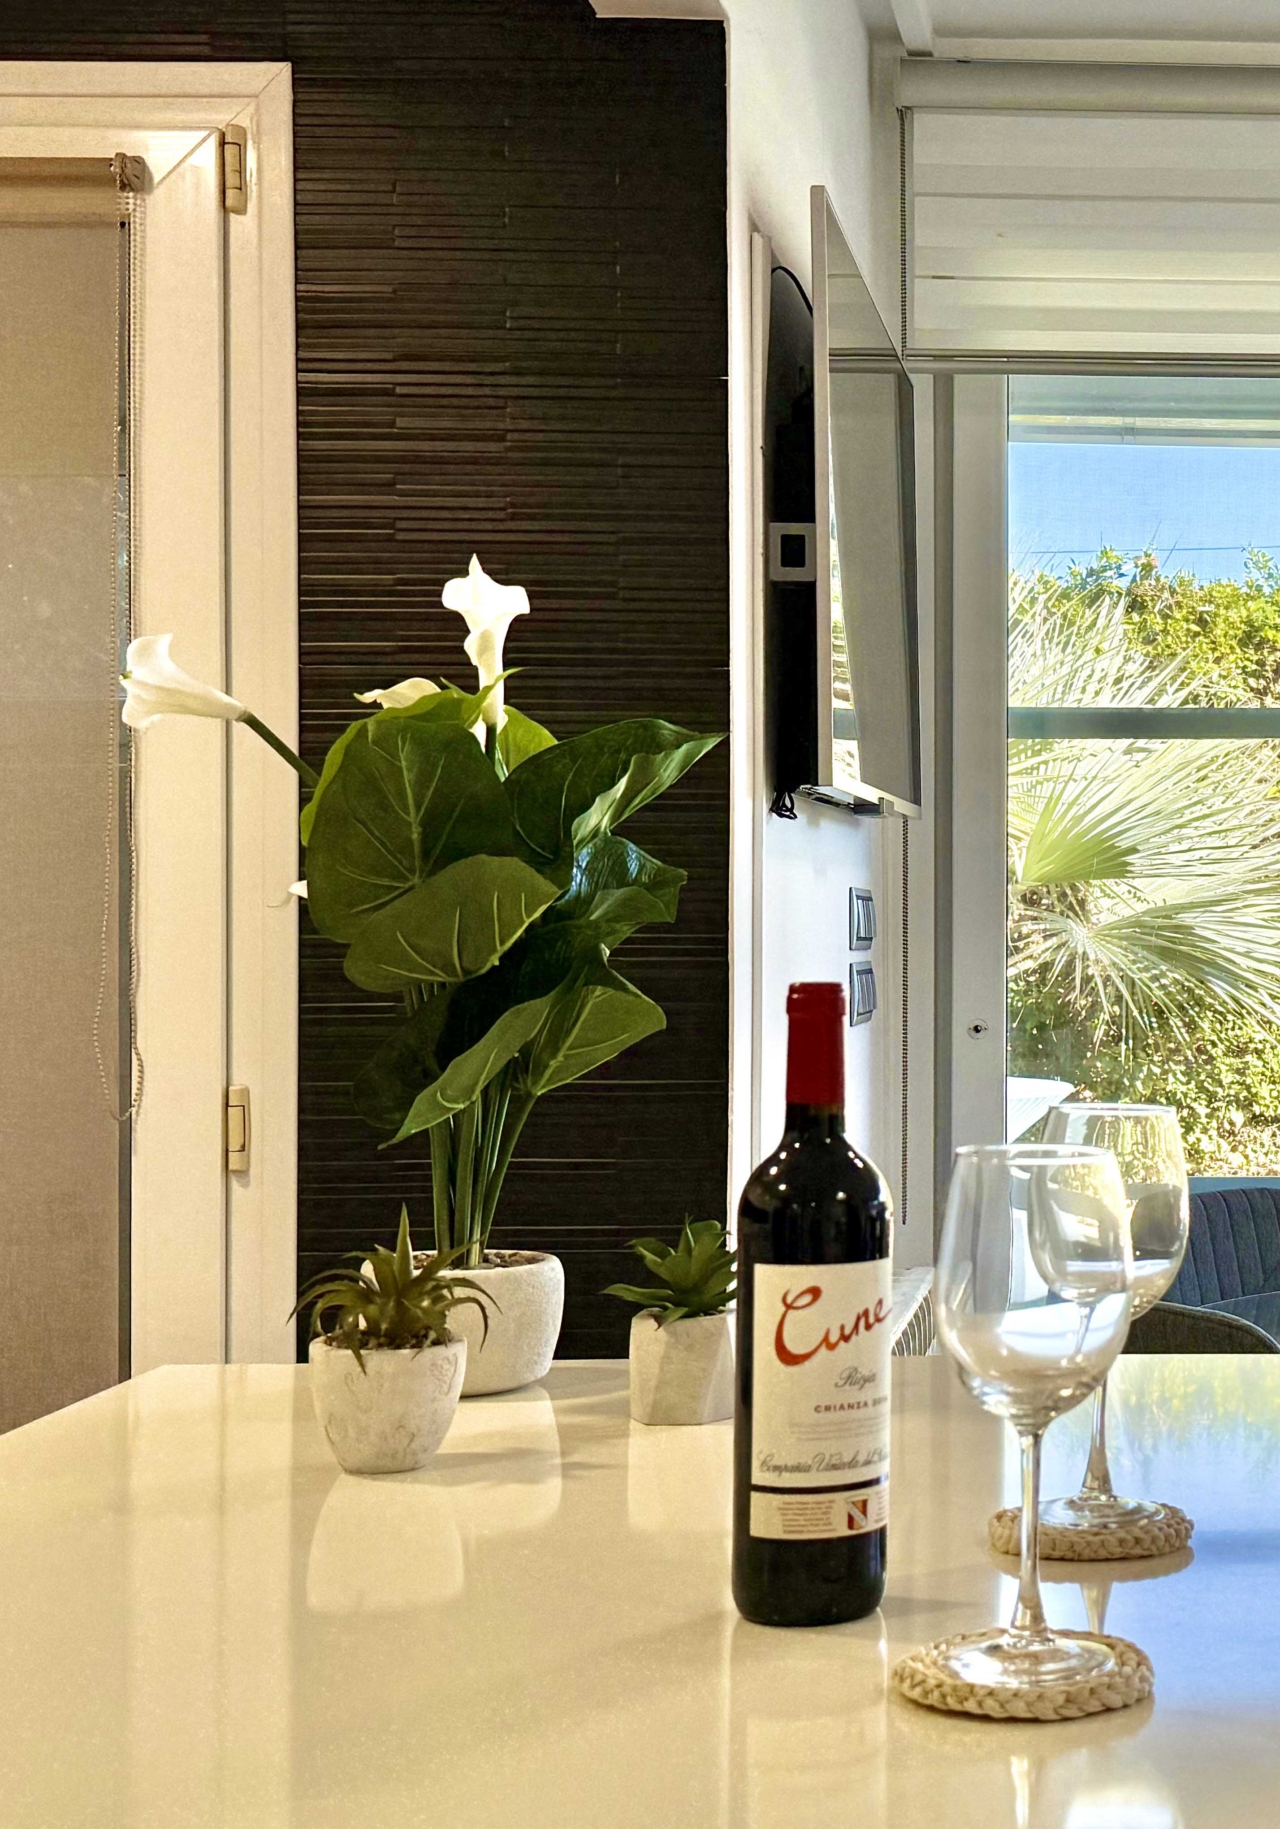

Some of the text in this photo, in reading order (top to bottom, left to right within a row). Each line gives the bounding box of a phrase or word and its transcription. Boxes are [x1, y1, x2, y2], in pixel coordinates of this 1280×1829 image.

[775, 1285, 892, 1367] Cune
[834, 1366, 876, 1390] Rioja
[814, 1400, 868, 1413] CRIANZA
